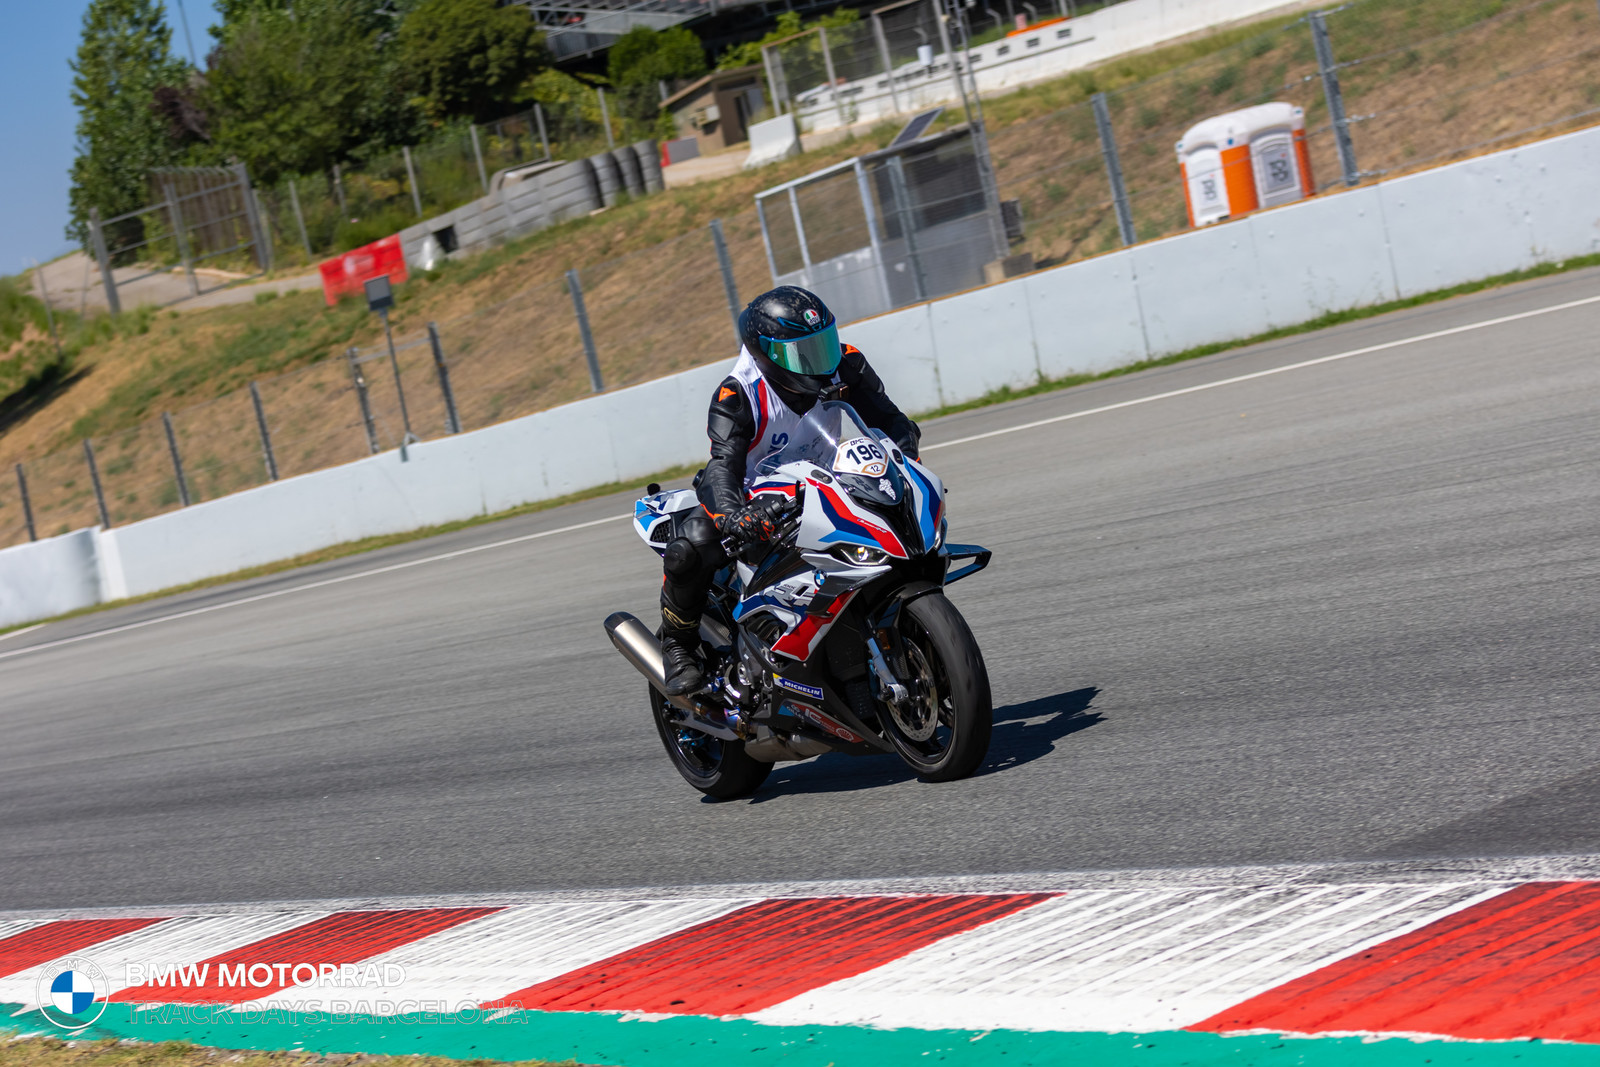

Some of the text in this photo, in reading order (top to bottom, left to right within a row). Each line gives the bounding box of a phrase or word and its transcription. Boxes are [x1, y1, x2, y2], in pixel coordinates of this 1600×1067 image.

[846, 443, 883, 465] 196
[870, 464, 881, 473] 12
[784, 681, 821, 696] MICHELIN
